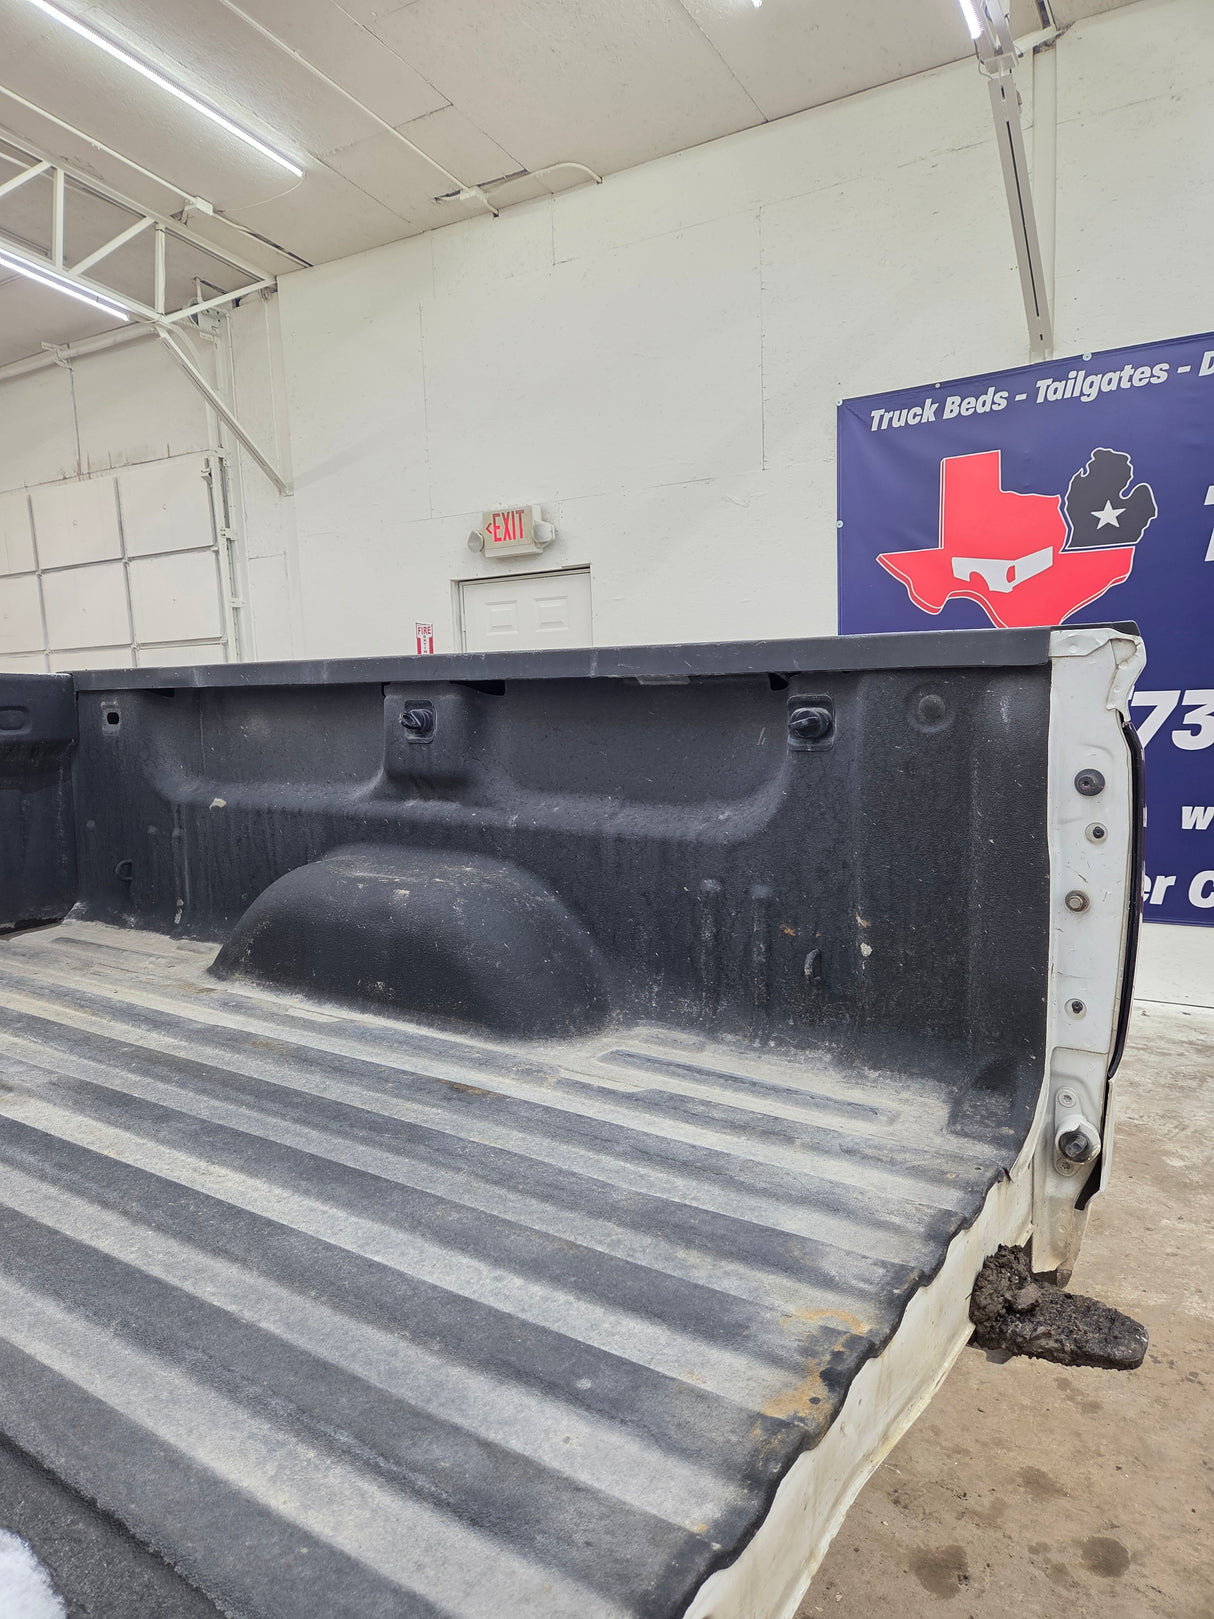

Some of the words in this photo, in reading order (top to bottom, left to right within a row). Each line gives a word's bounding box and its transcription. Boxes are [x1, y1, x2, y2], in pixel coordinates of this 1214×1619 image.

[870, 399, 939, 431] Truck
[943, 387, 1008, 419] Beds
[1035, 362, 1170, 403] Tailgates
[492, 509, 525, 542] EXIT
[417, 626, 432, 635] FIRE
